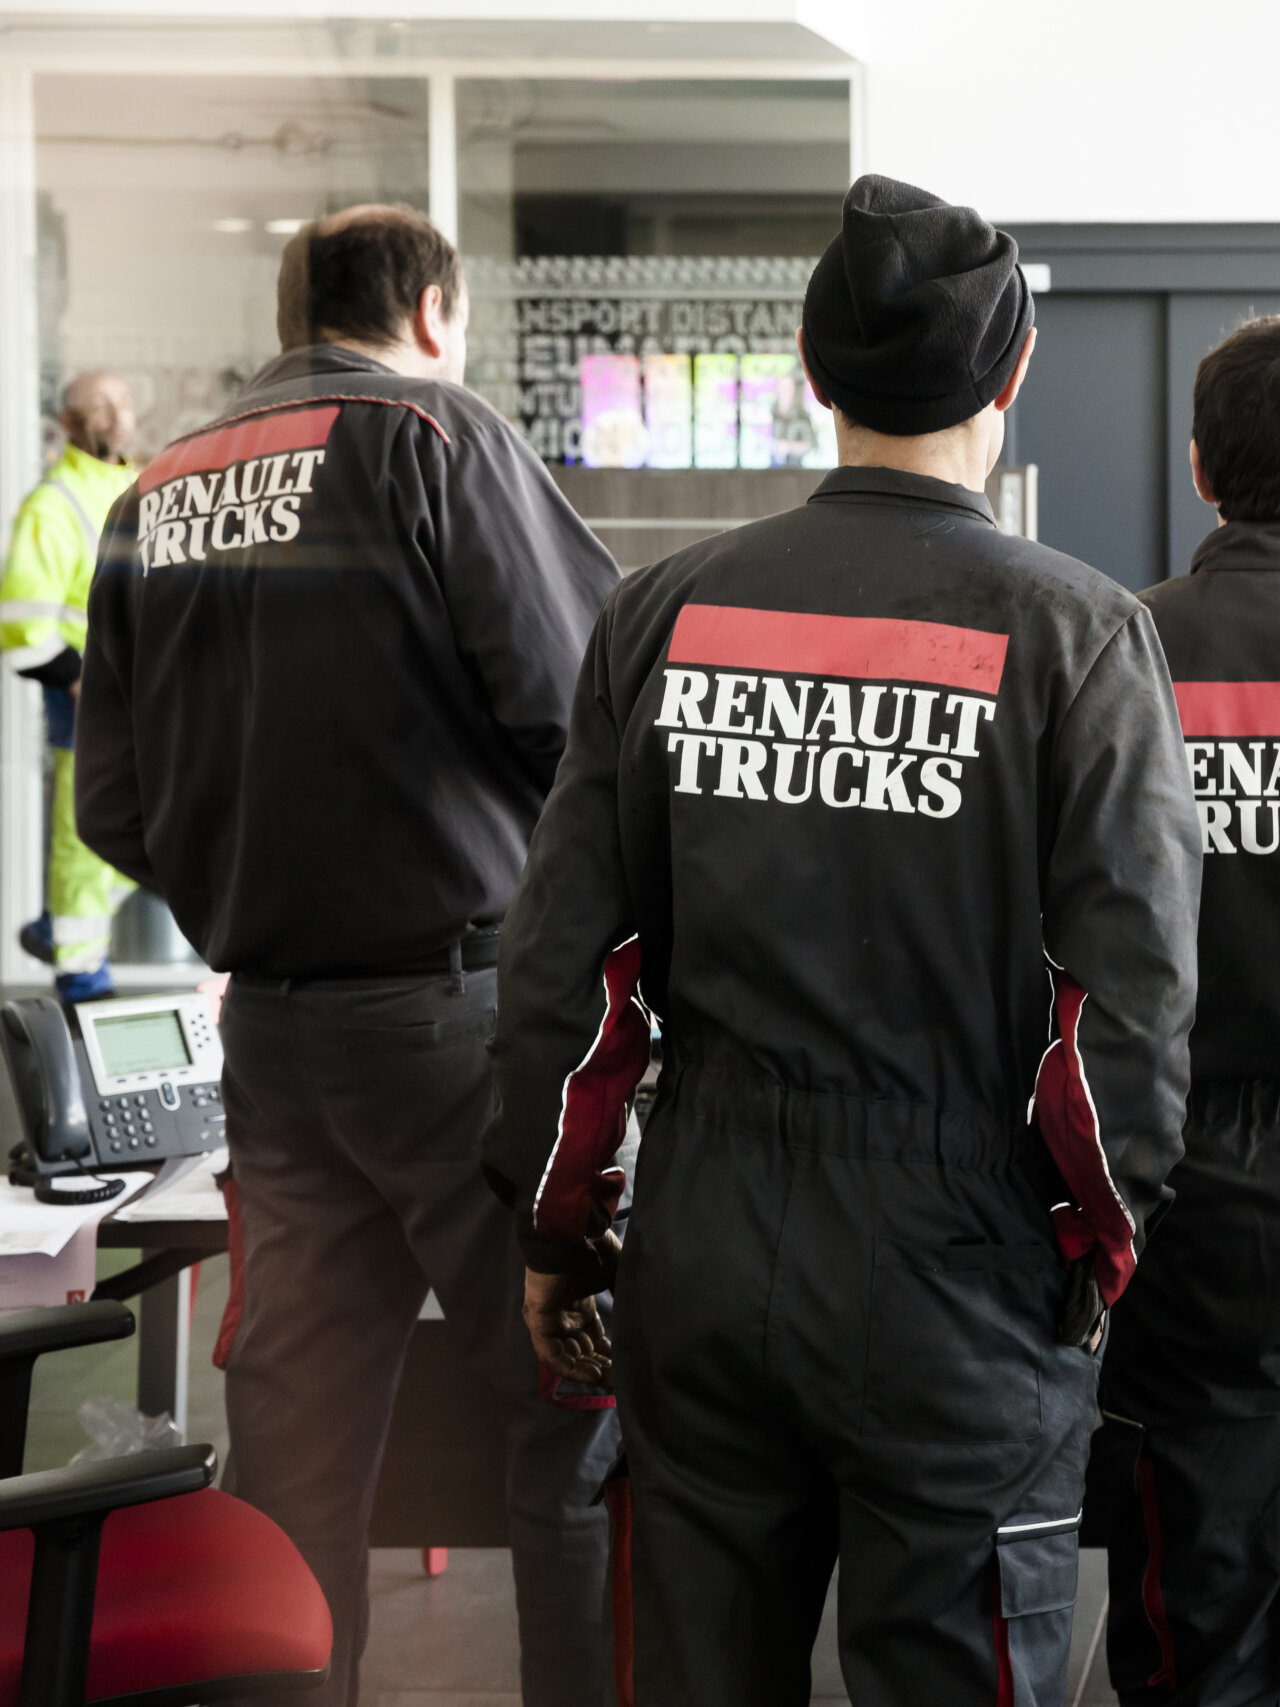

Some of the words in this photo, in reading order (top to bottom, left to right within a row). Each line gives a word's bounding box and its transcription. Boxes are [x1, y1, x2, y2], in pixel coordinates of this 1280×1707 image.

[474, 301, 661, 334] RANSPORT
[671, 301, 803, 336] DISTAN
[137, 449, 326, 542] RENAULT
[654, 668, 997, 758] RENAULT
[667, 732, 963, 819] TRUCKS
